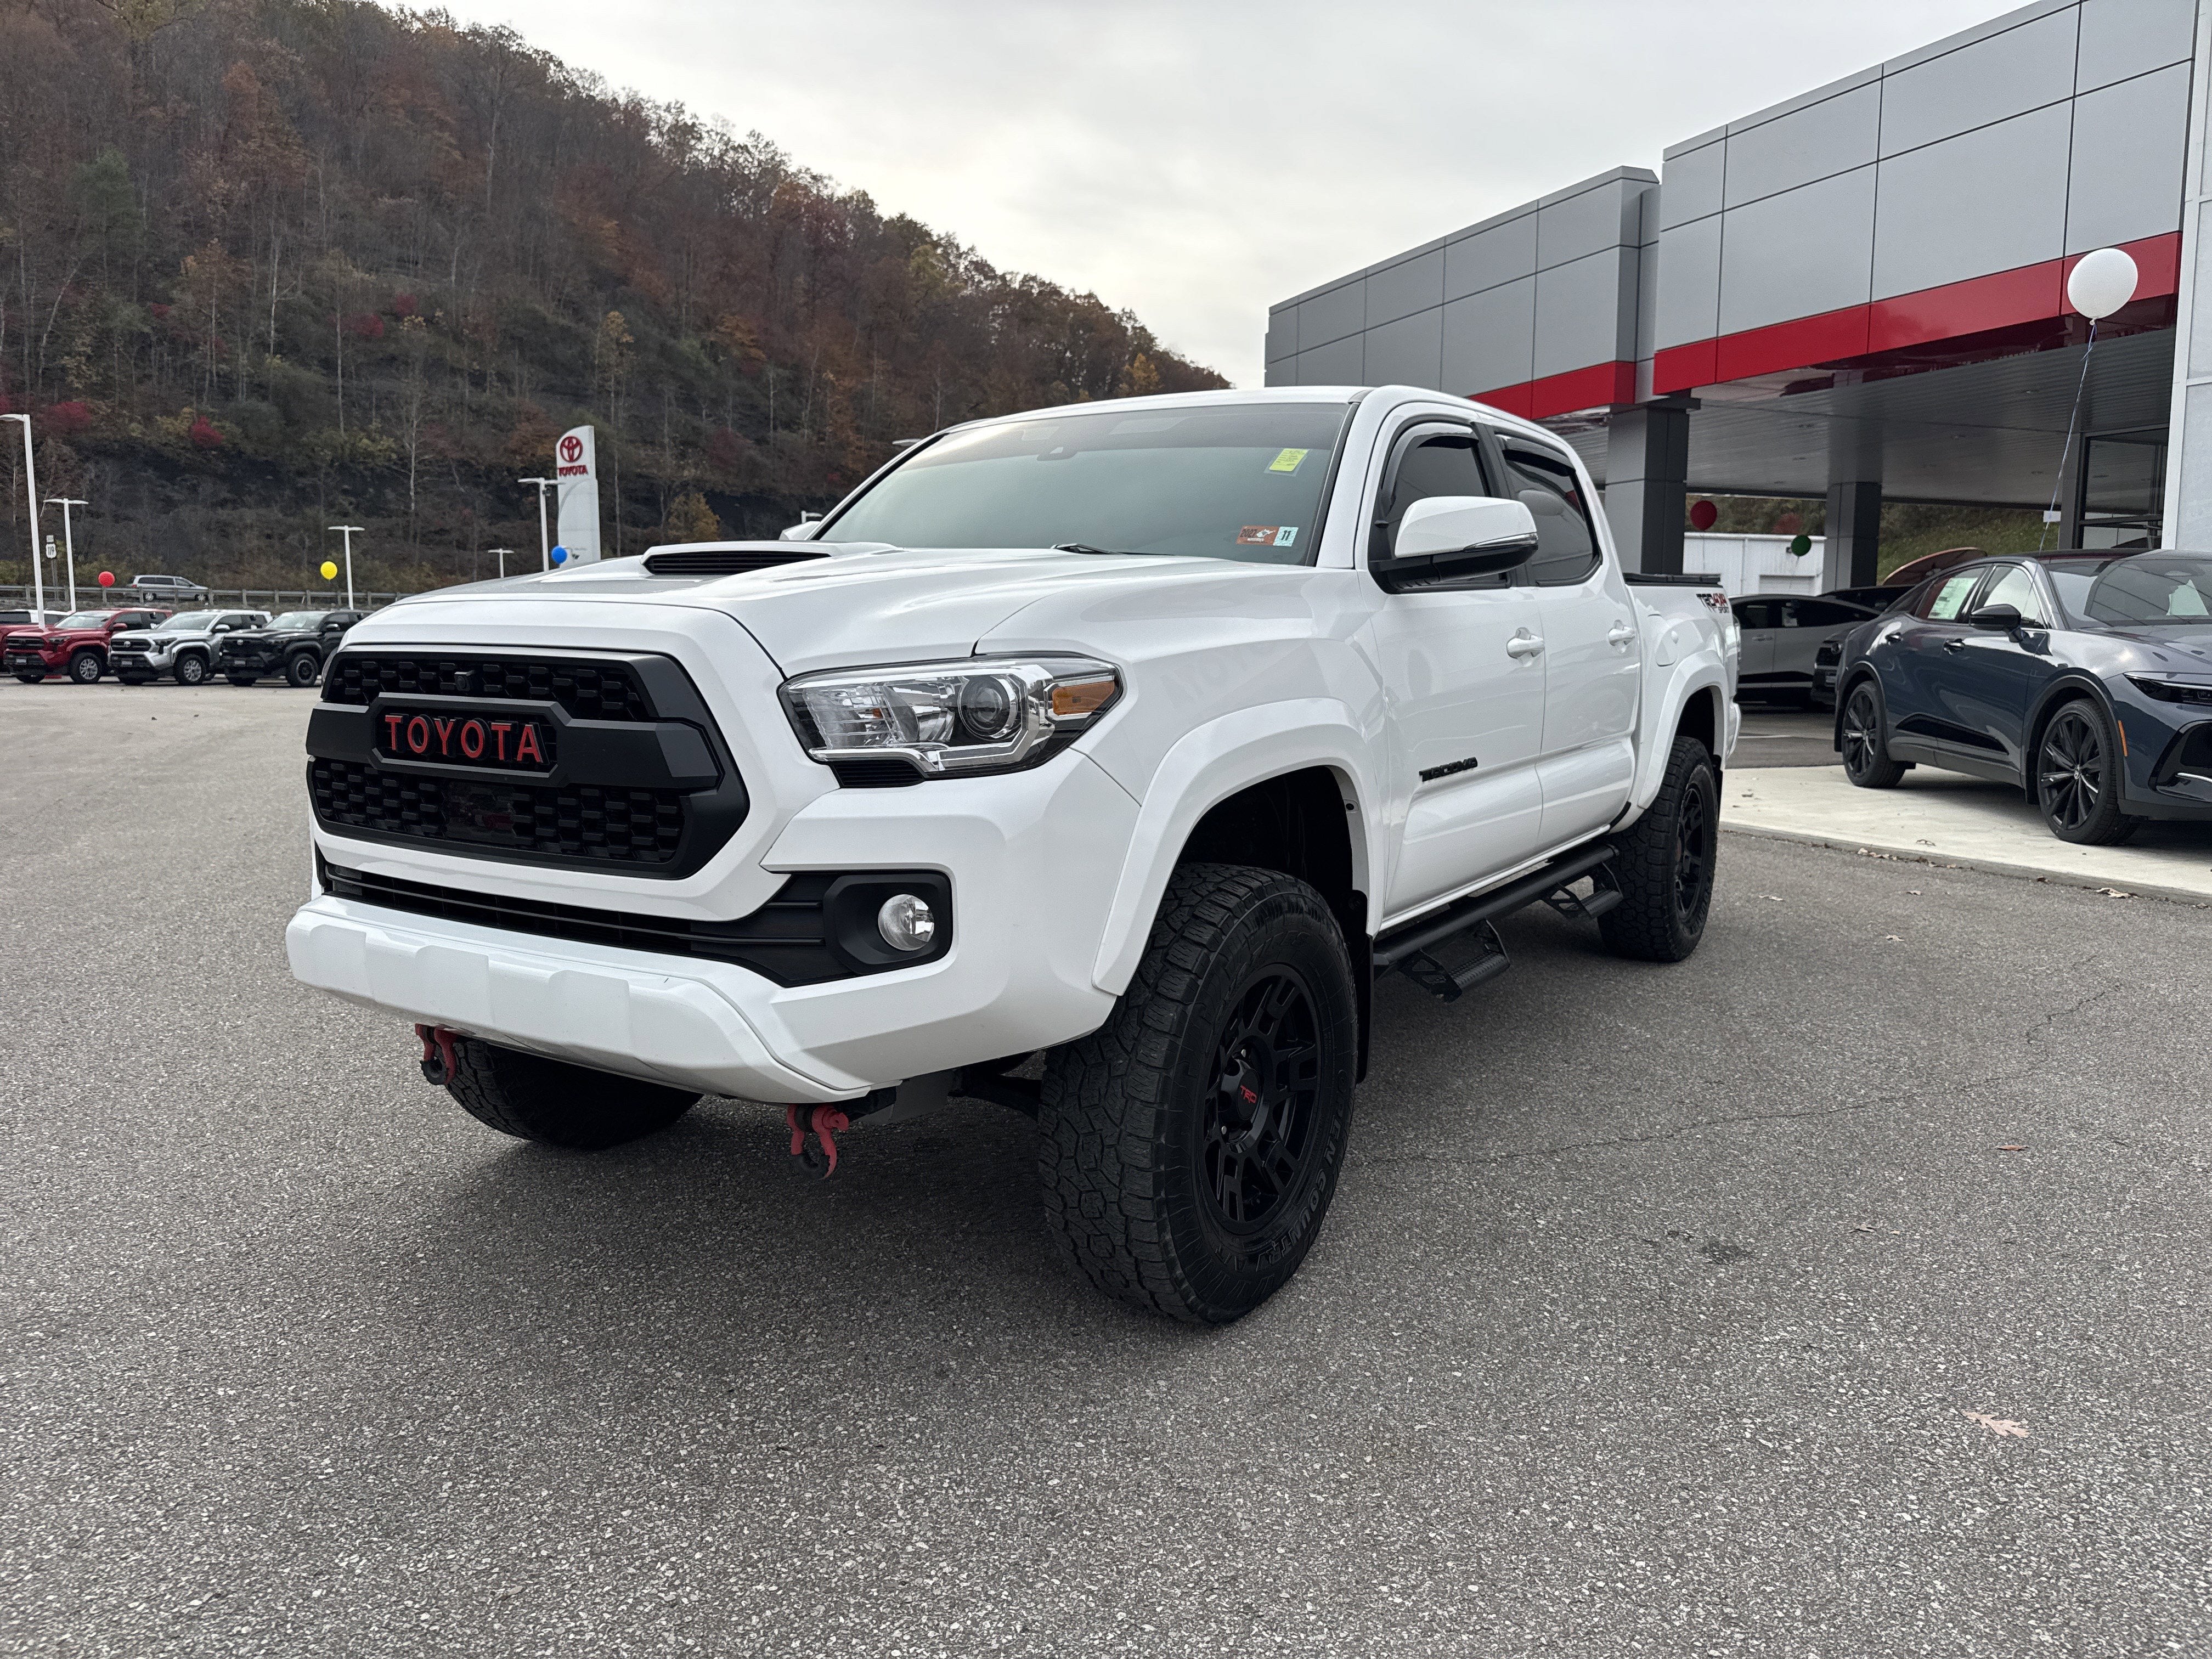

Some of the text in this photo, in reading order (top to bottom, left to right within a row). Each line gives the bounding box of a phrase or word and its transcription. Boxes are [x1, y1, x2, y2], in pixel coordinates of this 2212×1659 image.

[558, 465, 588, 477] TOYOTA
[1281, 530, 1291, 541] 11
[1696, 594, 1717, 612] TRD
[385, 714, 545, 764] TOYOTA
[1419, 757, 1478, 782] TACOMA
[1239, 1084, 1257, 1104] TRD
[1323, 1069, 1347, 1167] OPEN
[1255, 1169, 1327, 1272] COUNTRY
